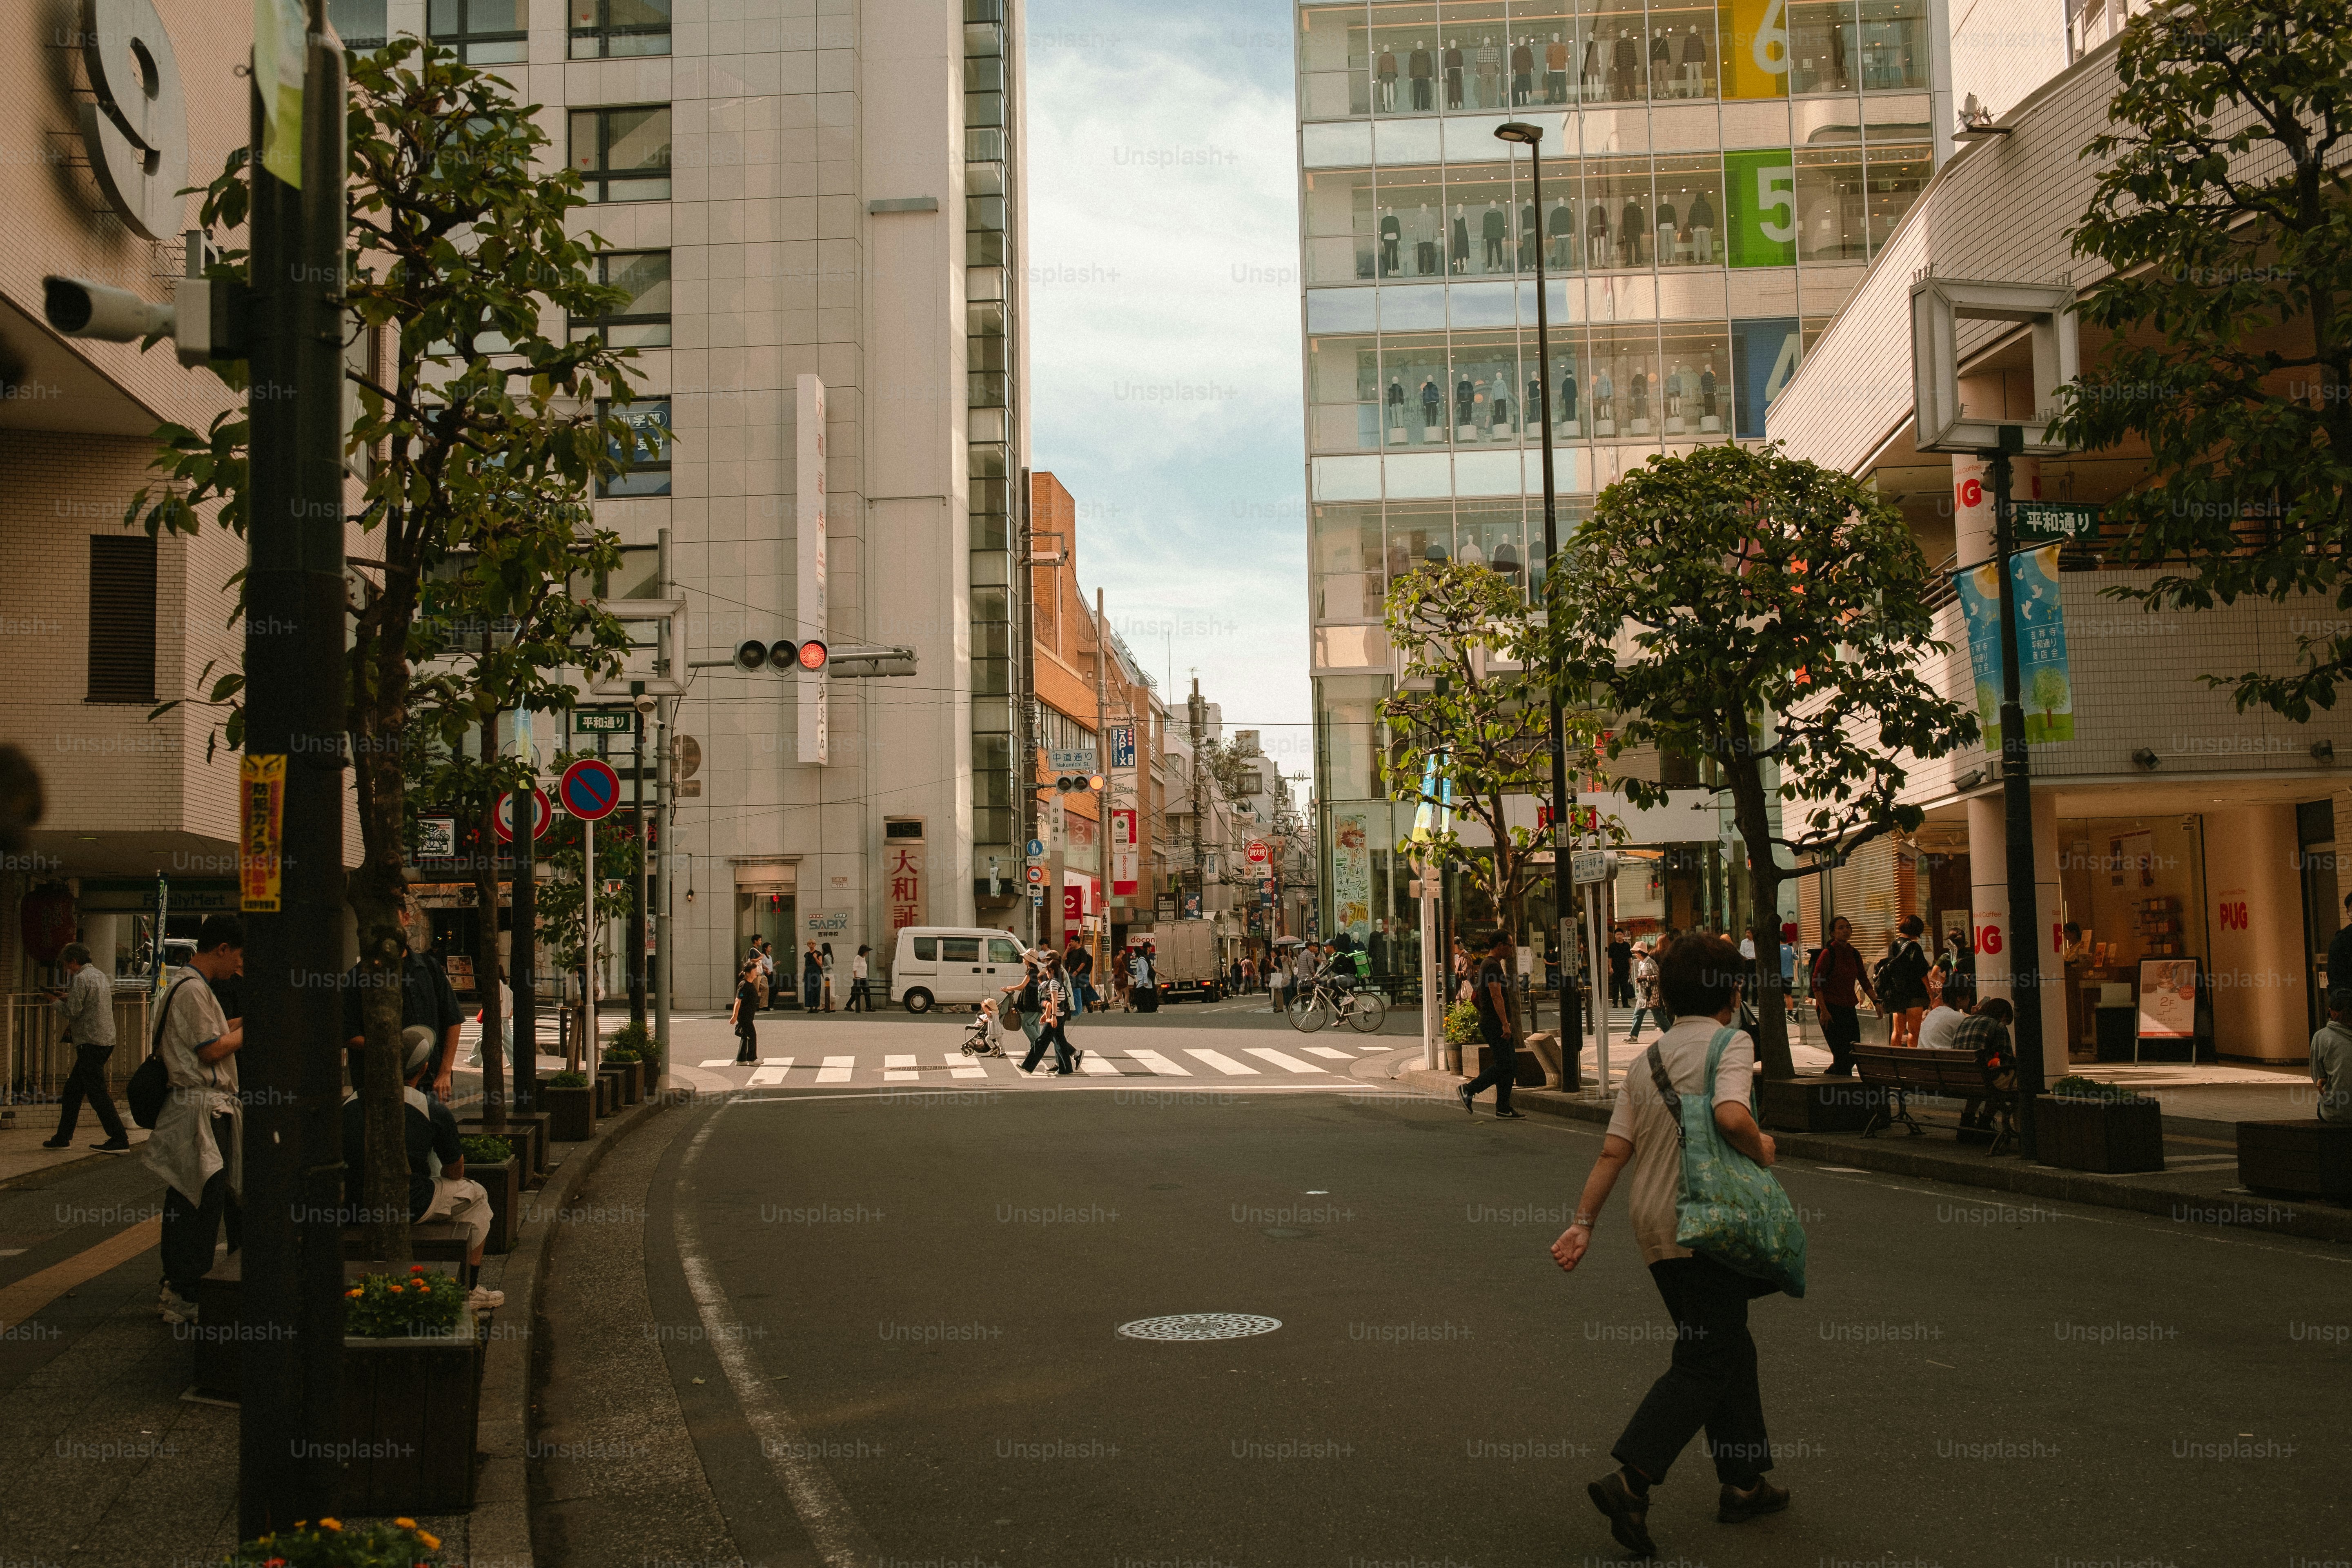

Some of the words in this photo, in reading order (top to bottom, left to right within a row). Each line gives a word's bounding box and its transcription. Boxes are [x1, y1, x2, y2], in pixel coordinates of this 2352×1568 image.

[1753, 0, 1788, 75] 6
[1757, 166, 1795, 243] 5
[1962, 465, 1981, 473] Coffee
[2026, 512, 2090, 532] 平和通り
[2031, 628, 2056, 640] 吉祥寺
[2031, 637, 2057, 650] 平和通り
[2032, 648, 2058, 660] 商店会
[583, 717, 624, 728] 平和通り
[1052, 752, 1092, 762] 中道通り
[1581, 858, 1597, 870] 吉祥寺駅
[891, 850, 918, 929] 大和証
[2219, 902, 2247, 931] PUG
[809, 919, 848, 930] SAPIX
[2160, 997, 2174, 1006] 2F
